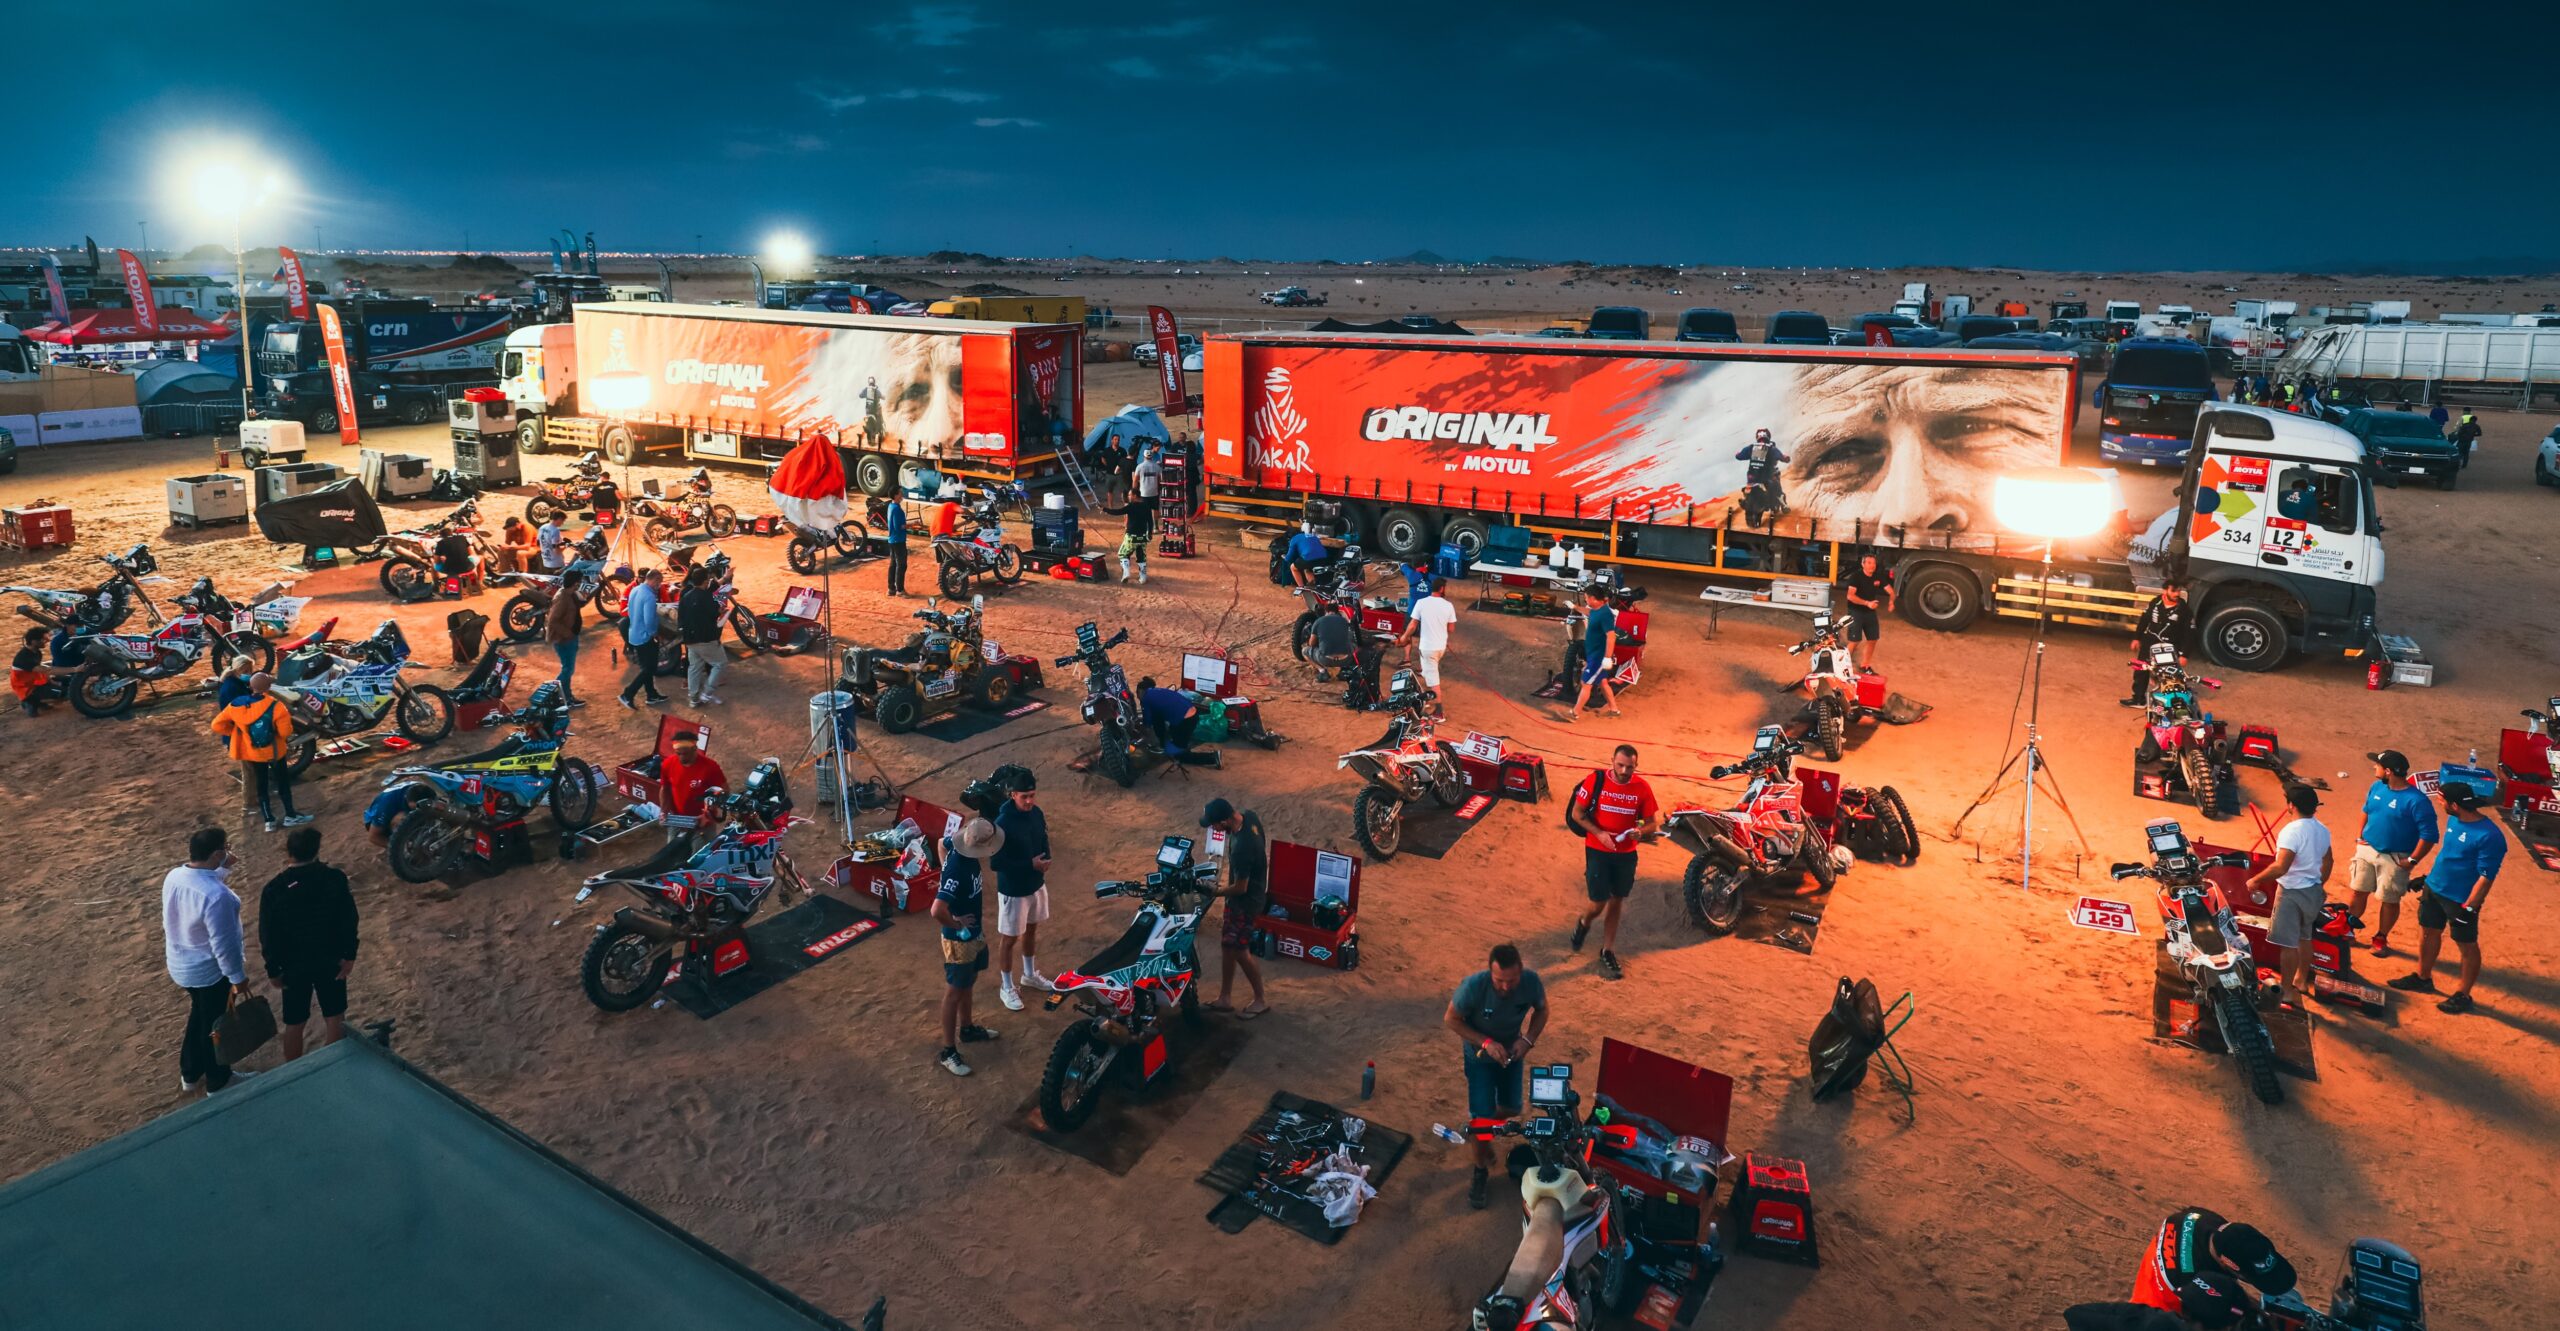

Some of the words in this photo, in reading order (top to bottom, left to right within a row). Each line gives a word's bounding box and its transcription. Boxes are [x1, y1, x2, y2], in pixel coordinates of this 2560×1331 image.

[369, 322, 408, 337] crn
[664, 358, 769, 393] ORIGINAL
[1162, 350, 1177, 391] ORIGINAL
[719, 395, 757, 409] MOTUL
[1364, 404, 1559, 454] ORIGINAL
[1247, 434, 1314, 474] DAKAR
[1444, 463, 1458, 471] BY
[1462, 455, 1532, 475] MOTUL
[2233, 466, 2264, 475] MOTUL
[2223, 529, 2252, 545] 534
[2272, 529, 2295, 547] L2
[2307, 553, 2342, 562] Transportation
[129, 641, 148, 652] 139
[305, 692, 320, 711] 120
[1472, 744, 1491, 756] 53
[1459, 795, 1487, 817] MOTUL
[2541, 802, 2560, 812] 10
[2088, 911, 2124, 928] 129
[810, 920, 874, 955] MOTUL
[1280, 942, 1301, 955] 123
[1681, 1141, 1709, 1157] 103
[2183, 1220, 2193, 1232] CA
[2164, 1223, 2177, 1269] KTM
